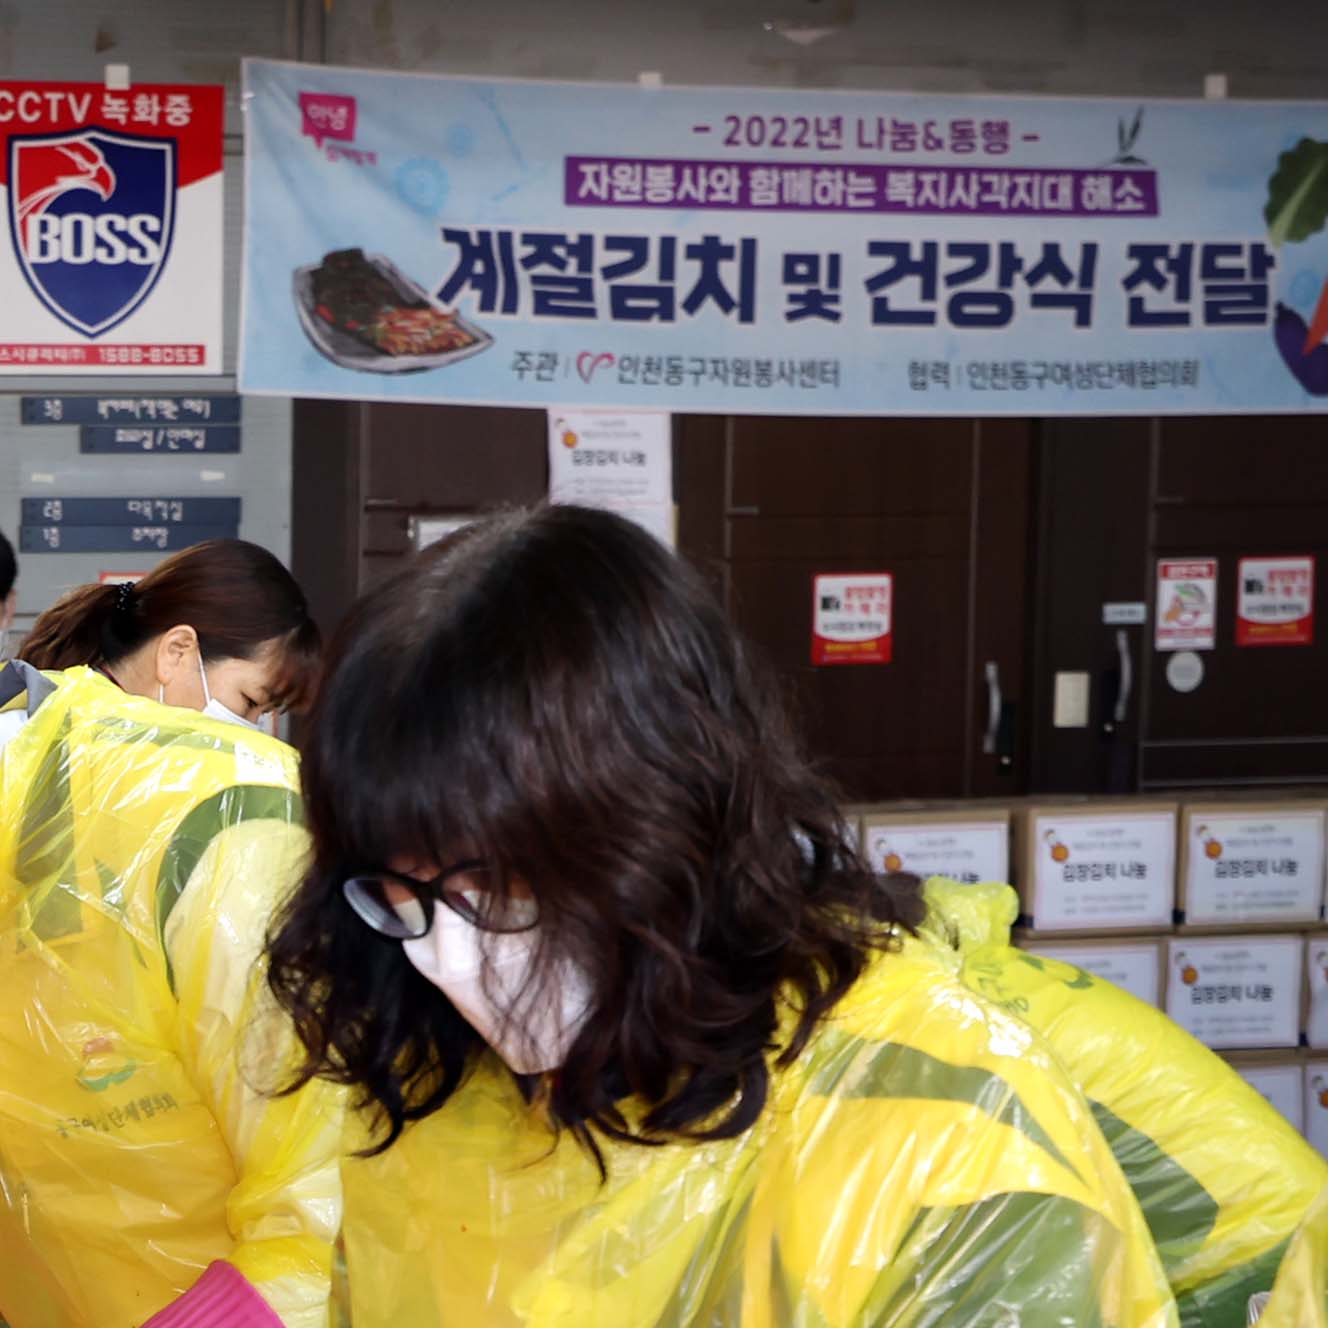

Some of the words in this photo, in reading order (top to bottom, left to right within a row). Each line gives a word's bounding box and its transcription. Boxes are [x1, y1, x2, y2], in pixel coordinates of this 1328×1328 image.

[101, 93, 193, 126] 녹화중
[723, 115, 843, 151] 2022년
[857, 117, 1010, 154] 나눔&동행
[578, 163, 741, 203] 자원봉사와
[749, 168, 877, 208] 함께하는
[885, 171, 1074, 209] 복지사각지대
[1081, 175, 1146, 210] 해소
[27, 213, 162, 265] BOSS
[437, 227, 758, 325] 계절김치
[782, 253, 842, 323] 및
[864, 241, 1099, 328] 건강식
[1122, 242, 1277, 328] 전달
[512, 351, 559, 382] 주관
[618, 353, 842, 388] 인천동구자원봉사센터
